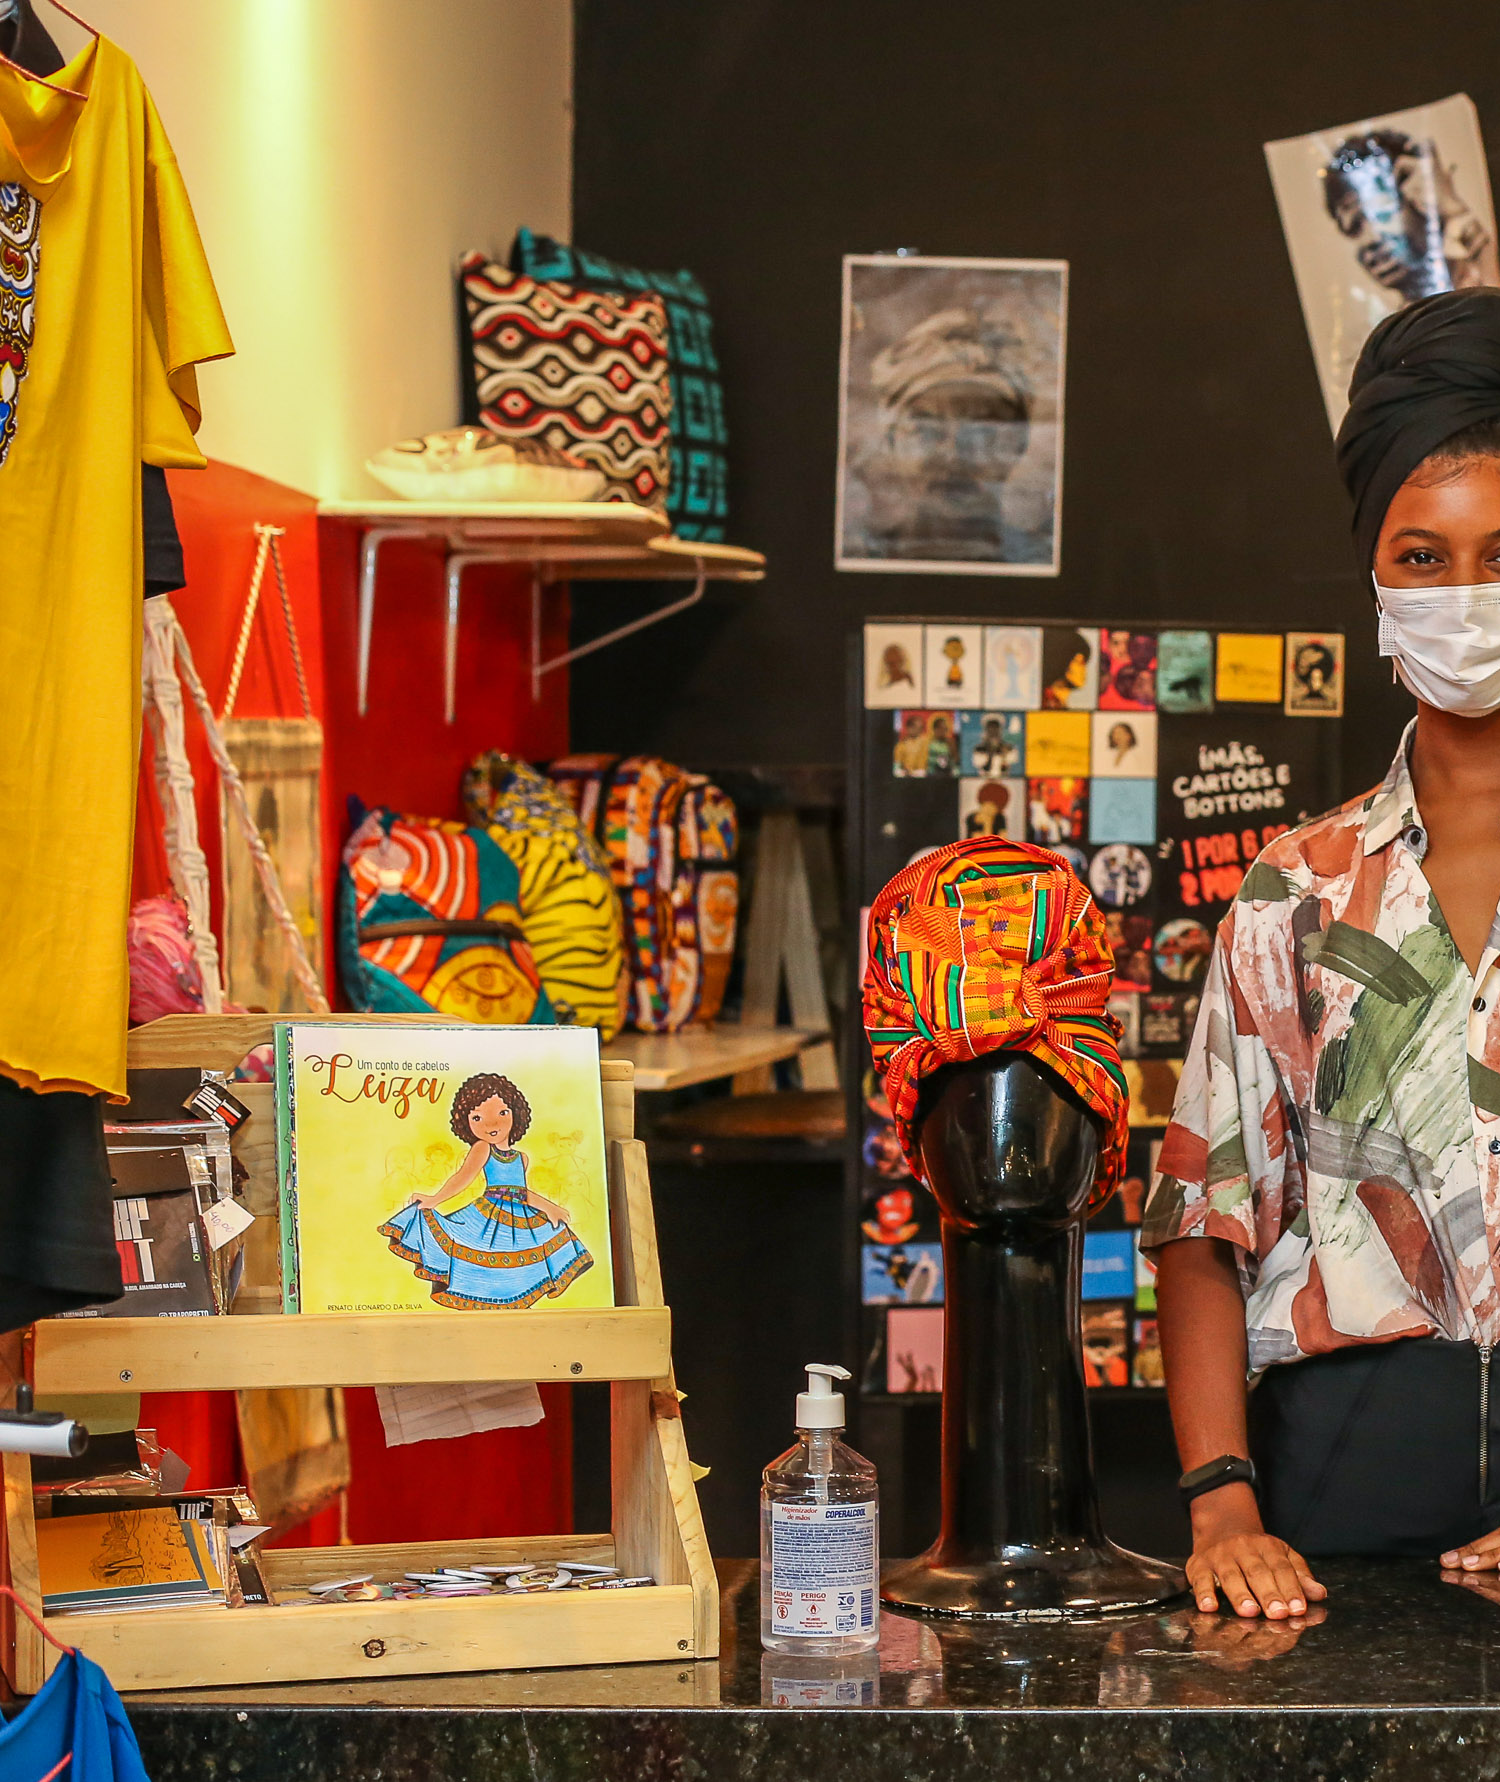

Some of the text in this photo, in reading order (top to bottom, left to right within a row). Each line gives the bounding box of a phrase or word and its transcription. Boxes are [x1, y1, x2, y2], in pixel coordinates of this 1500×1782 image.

[1172, 763, 1291, 799] CARTÕES E
[1183, 787, 1285, 820] BOTTONS
[1181, 839, 1194, 870] 1
[1195, 832, 1240, 867] POR
[1179, 871, 1201, 907] 2
[357, 1059, 450, 1071] Um conto de cabelos
[303, 1053, 445, 1120] Leiza
[327, 1304, 353, 1312] RENATO
[355, 1303, 391, 1311] LEONARDO
[781, 1506, 818, 1515] Higienizador
[825, 1508, 866, 1519] COPERALCOOL
[774, 1590, 793, 1598] ATENÇÃO
